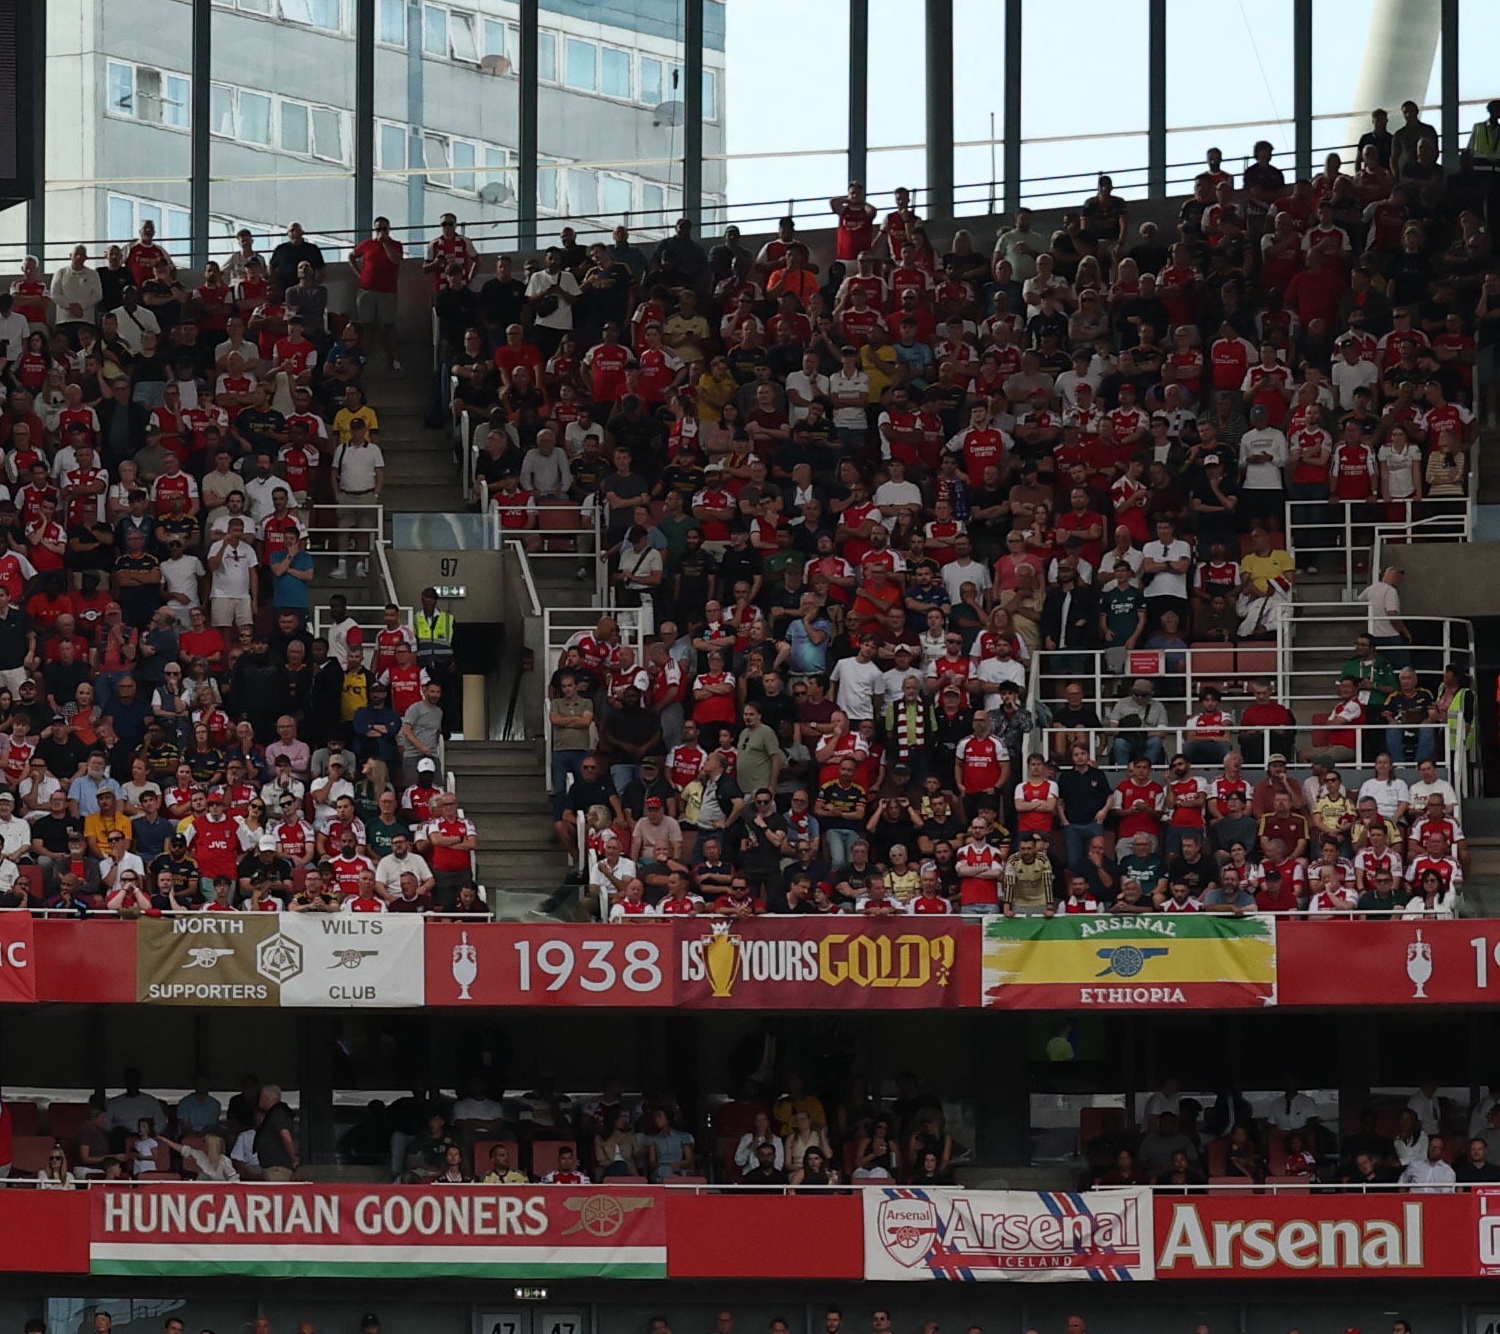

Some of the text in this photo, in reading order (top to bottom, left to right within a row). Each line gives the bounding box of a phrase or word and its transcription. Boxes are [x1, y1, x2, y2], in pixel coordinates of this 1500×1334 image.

[441, 557, 458, 577] 97
[208, 841, 228, 849] JVC
[173, 919, 383, 935] NORTH WILTS
[1079, 916, 1178, 939] ARSENAL
[514, 938, 663, 994] 1938
[682, 933, 955, 988] IS YOURS GOLD?
[149, 983, 377, 1001] SUPPORTERS CLUB
[1079, 986, 1187, 1005] ETHIOPIA
[105, 1191, 548, 1238] HUNGARIAN GOONERS
[886, 1208, 930, 1223] Arsenal
[941, 1197, 1139, 1251] Arsenal
[1157, 1201, 1425, 1269] Arsenal
[998, 1255, 1074, 1268] ICELAND
